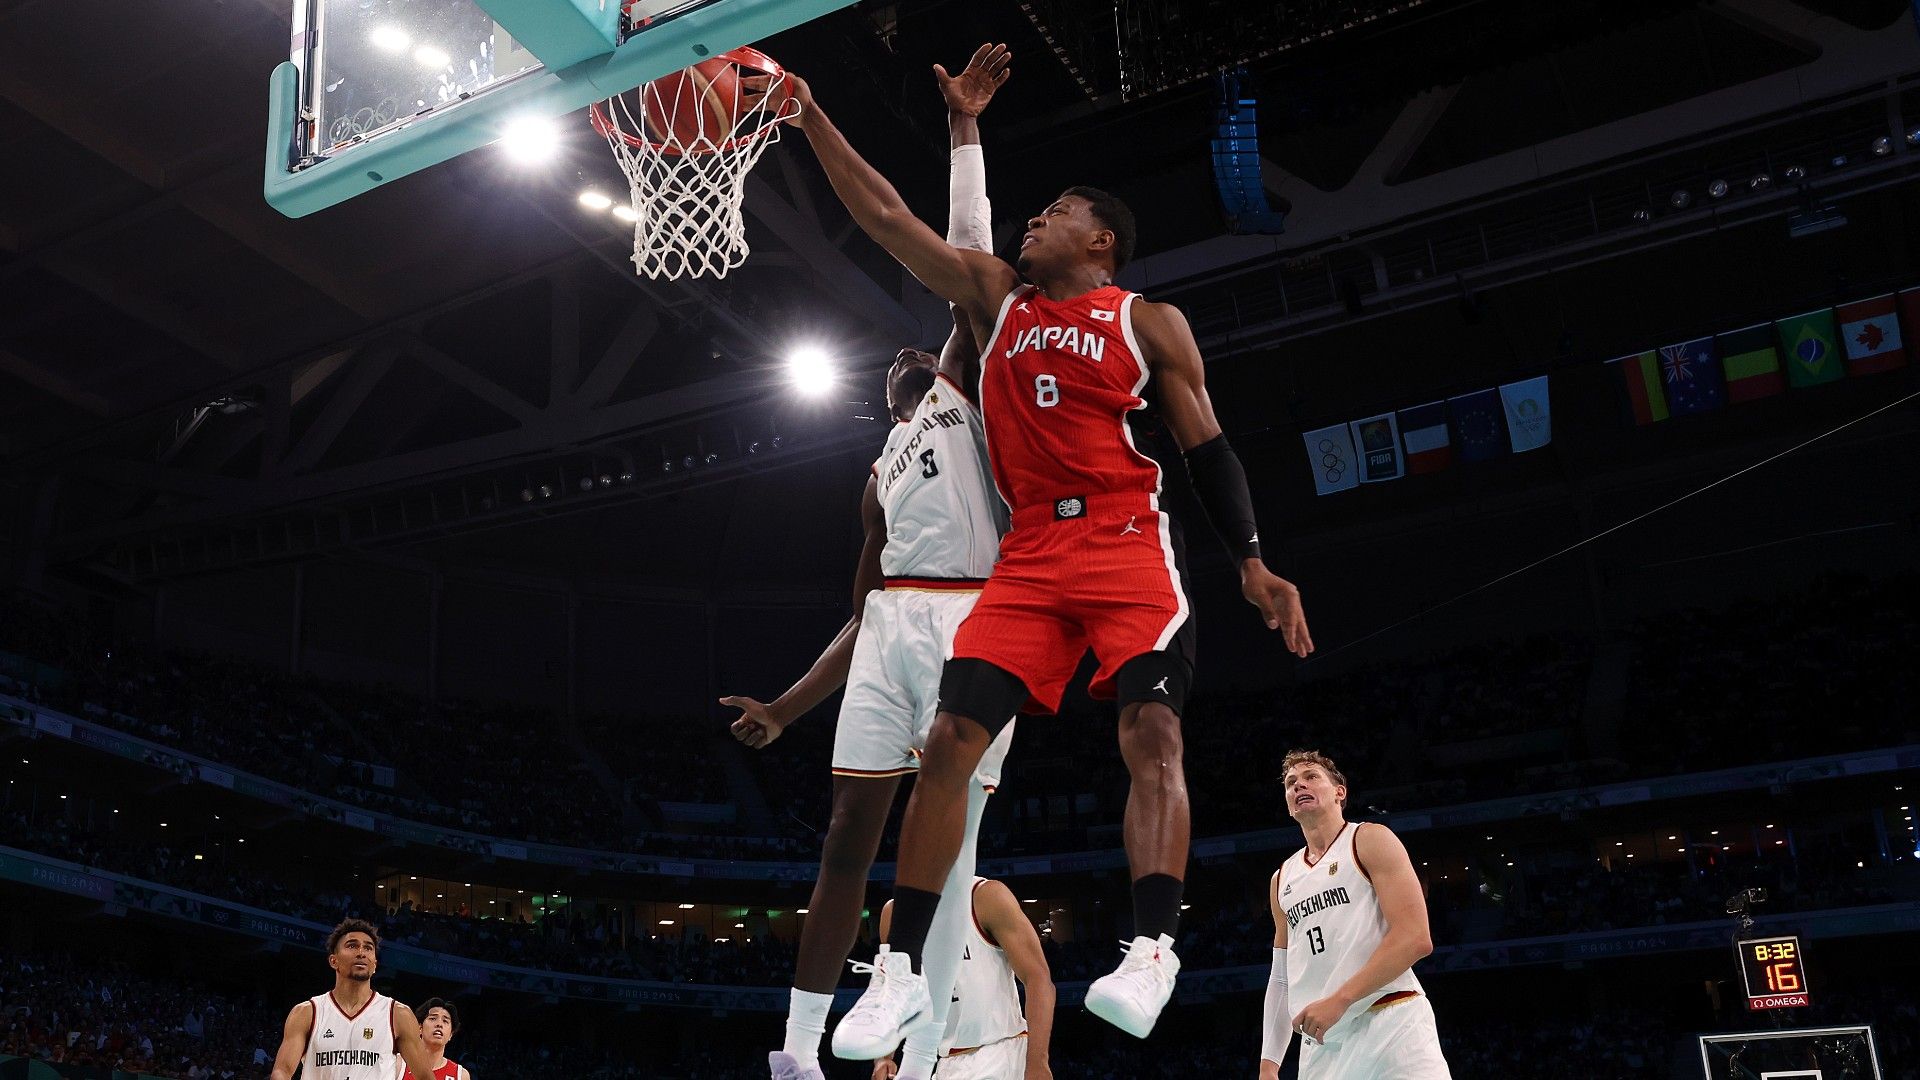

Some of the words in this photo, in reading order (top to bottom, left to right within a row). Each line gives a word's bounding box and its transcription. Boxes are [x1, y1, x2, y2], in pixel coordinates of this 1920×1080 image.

[1006, 325, 1105, 362] JAPAN
[1035, 374, 1059, 407] 8
[1370, 453, 1392, 466] FIBA
[33, 867, 68, 885] PARIS
[1285, 886, 1351, 929] EUTSCHLAND
[251, 919, 279, 935] PARIS
[1306, 926, 1325, 955] 13
[1755, 943, 1795, 960] 8:32
[1766, 963, 1798, 991] 16
[1765, 997, 1805, 1007] OMEGA
